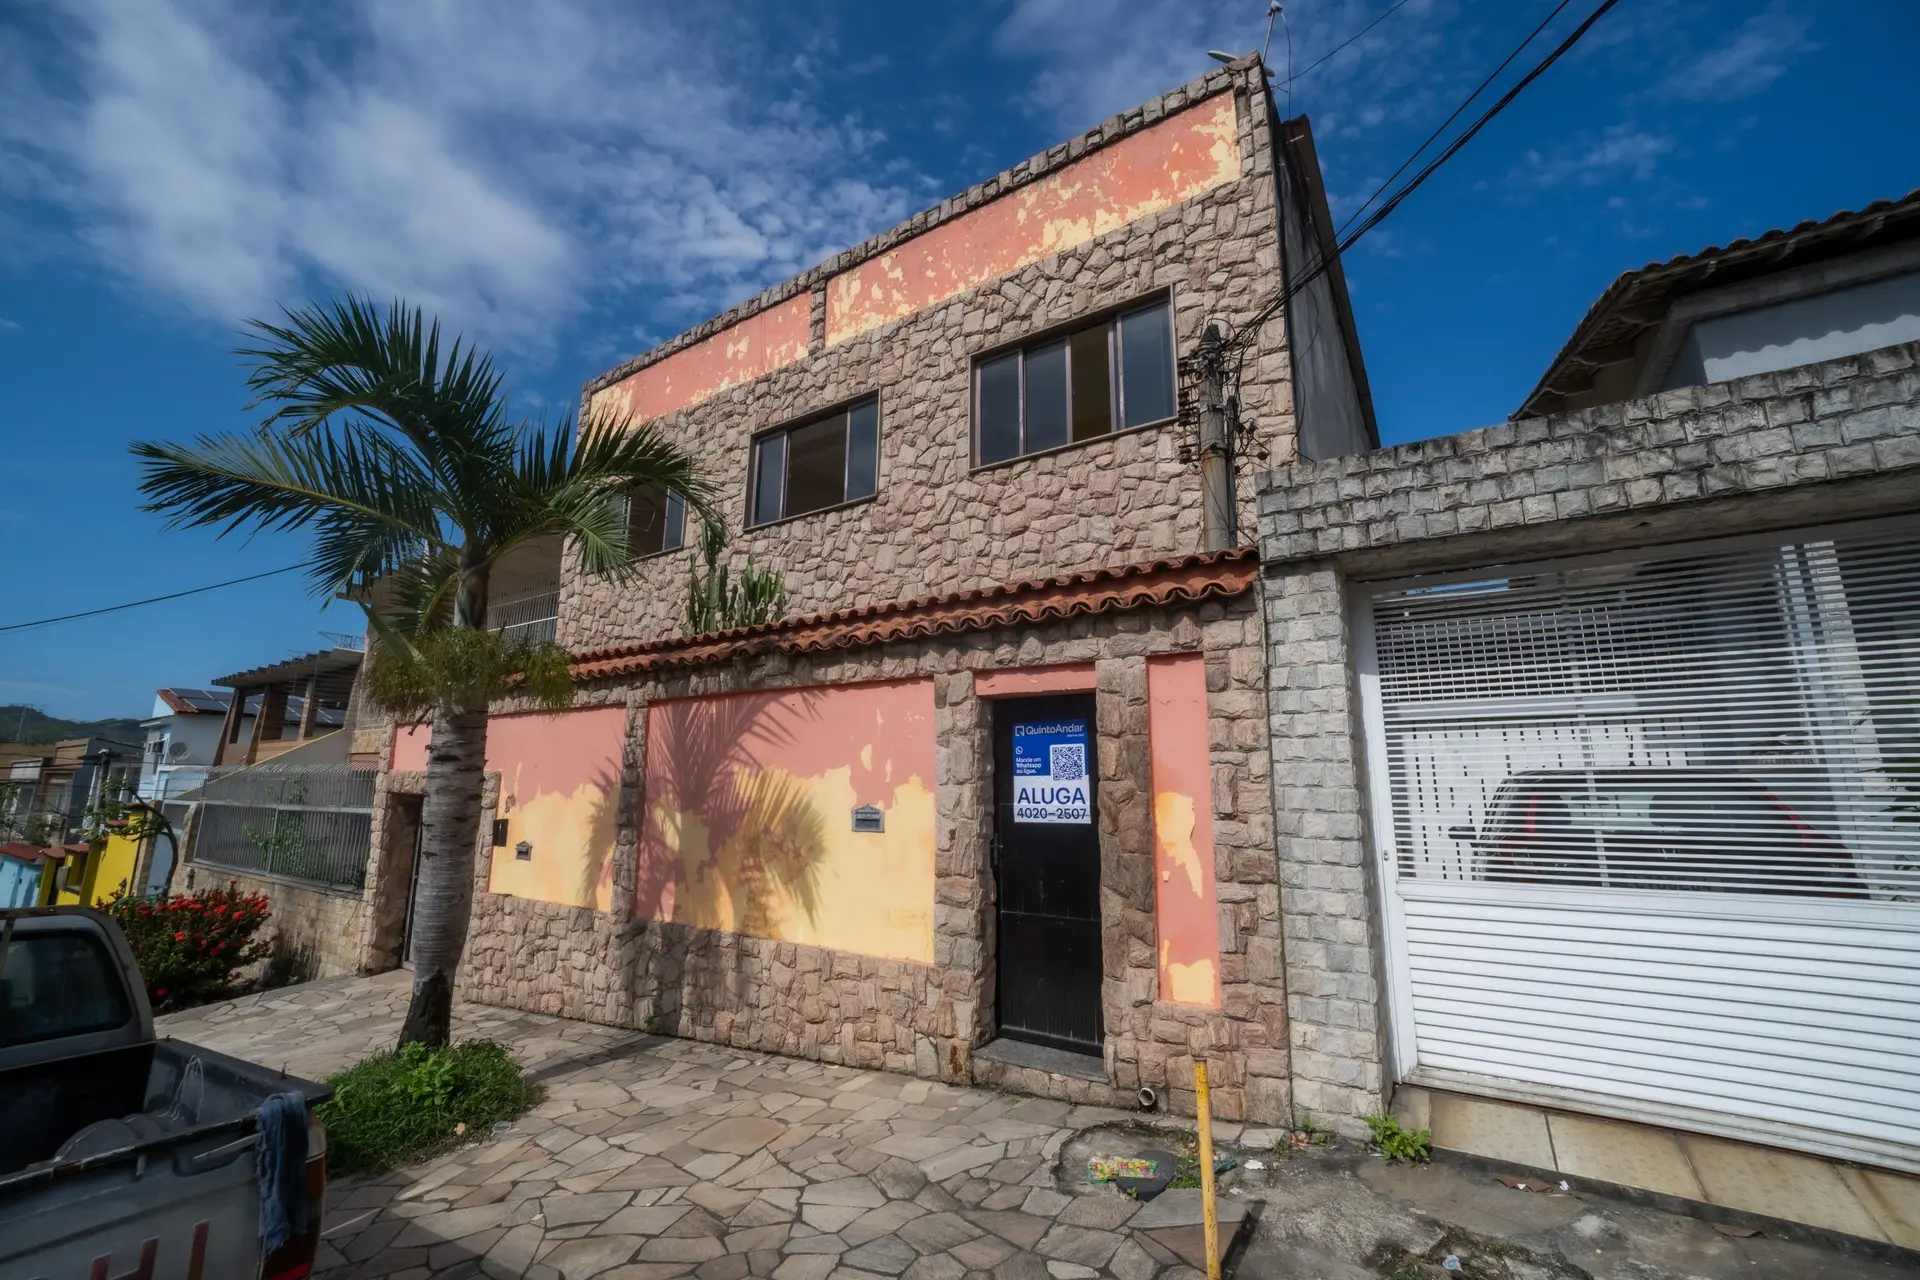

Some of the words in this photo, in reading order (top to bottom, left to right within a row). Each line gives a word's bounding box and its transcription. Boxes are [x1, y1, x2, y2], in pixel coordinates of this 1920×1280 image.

[1026, 724, 1084, 735] QuintoAndar
[1017, 787, 1086, 805] ALUGA
[1017, 808, 1087, 819] 4020-2507
